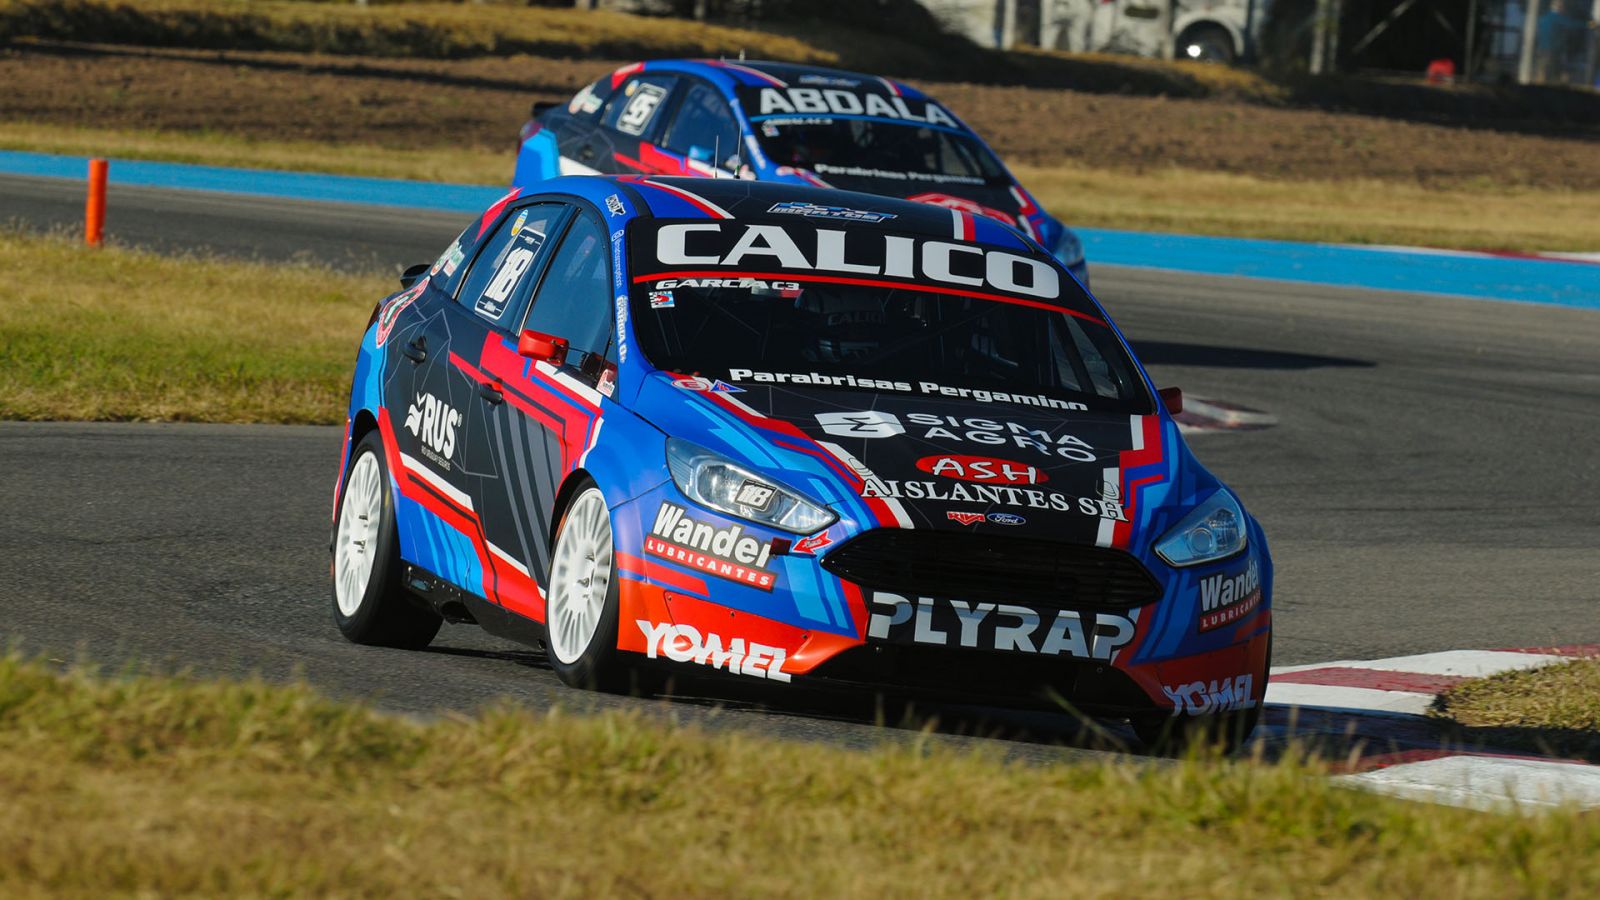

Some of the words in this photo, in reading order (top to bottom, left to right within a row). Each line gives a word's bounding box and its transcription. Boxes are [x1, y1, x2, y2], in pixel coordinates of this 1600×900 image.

[760, 88, 959, 128] ABDALA
[657, 223, 1060, 299] CALICO
[655, 279, 766, 290] GARCIA
[772, 282, 800, 291] C3
[729, 368, 912, 392] Parabrisas
[422, 392, 458, 459] RUS
[906, 413, 1094, 451] SIGMA
[924, 426, 1096, 462] AGRO
[932, 457, 1037, 484] ASH
[860, 478, 1069, 511] AISLANTES
[1078, 497, 1129, 522] SH
[994, 513, 1020, 524] Ford
[647, 539, 770, 586] LUBRICANTES
[868, 591, 1135, 660] PLYRAP
[635, 619, 791, 683] YOMEL
[1162, 673, 1257, 717] YOMEL
